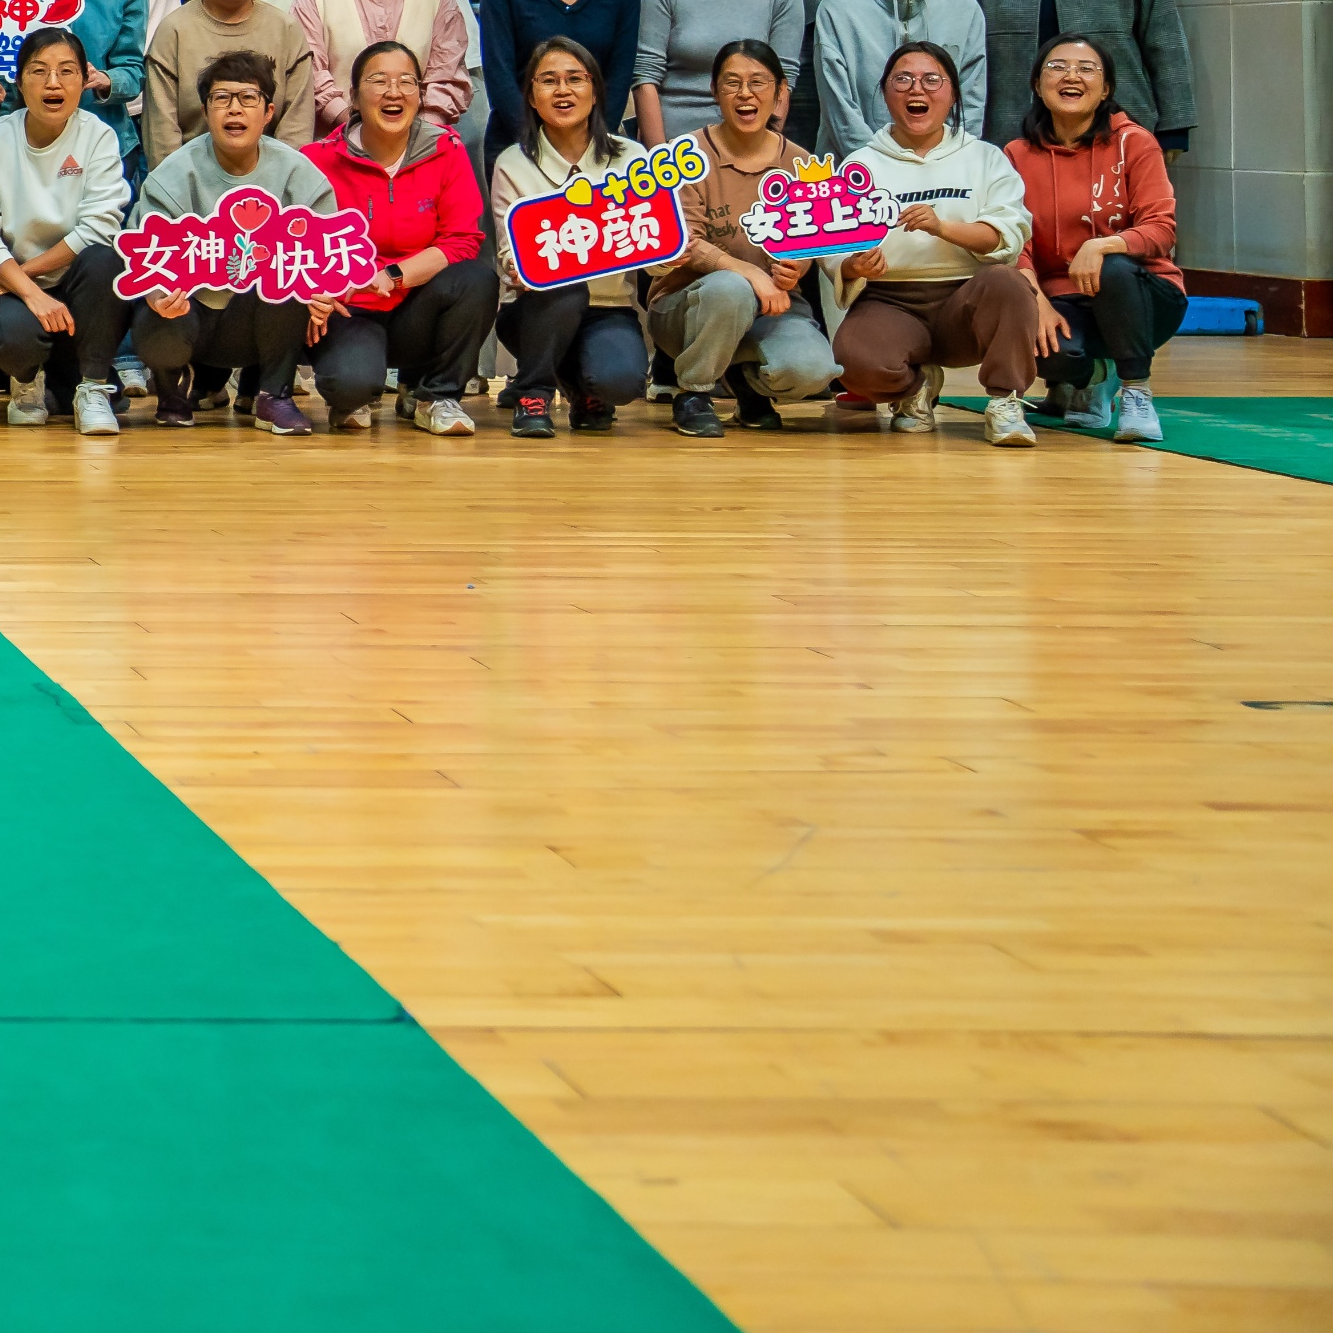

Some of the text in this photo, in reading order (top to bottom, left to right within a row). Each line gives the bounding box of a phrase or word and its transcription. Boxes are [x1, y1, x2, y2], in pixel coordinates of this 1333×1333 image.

[806, 182, 831, 198] 38
[896, 188, 973, 204] YNAMIC
[742, 189, 900, 243] 女王上场
[535, 202, 661, 271] 神颜
